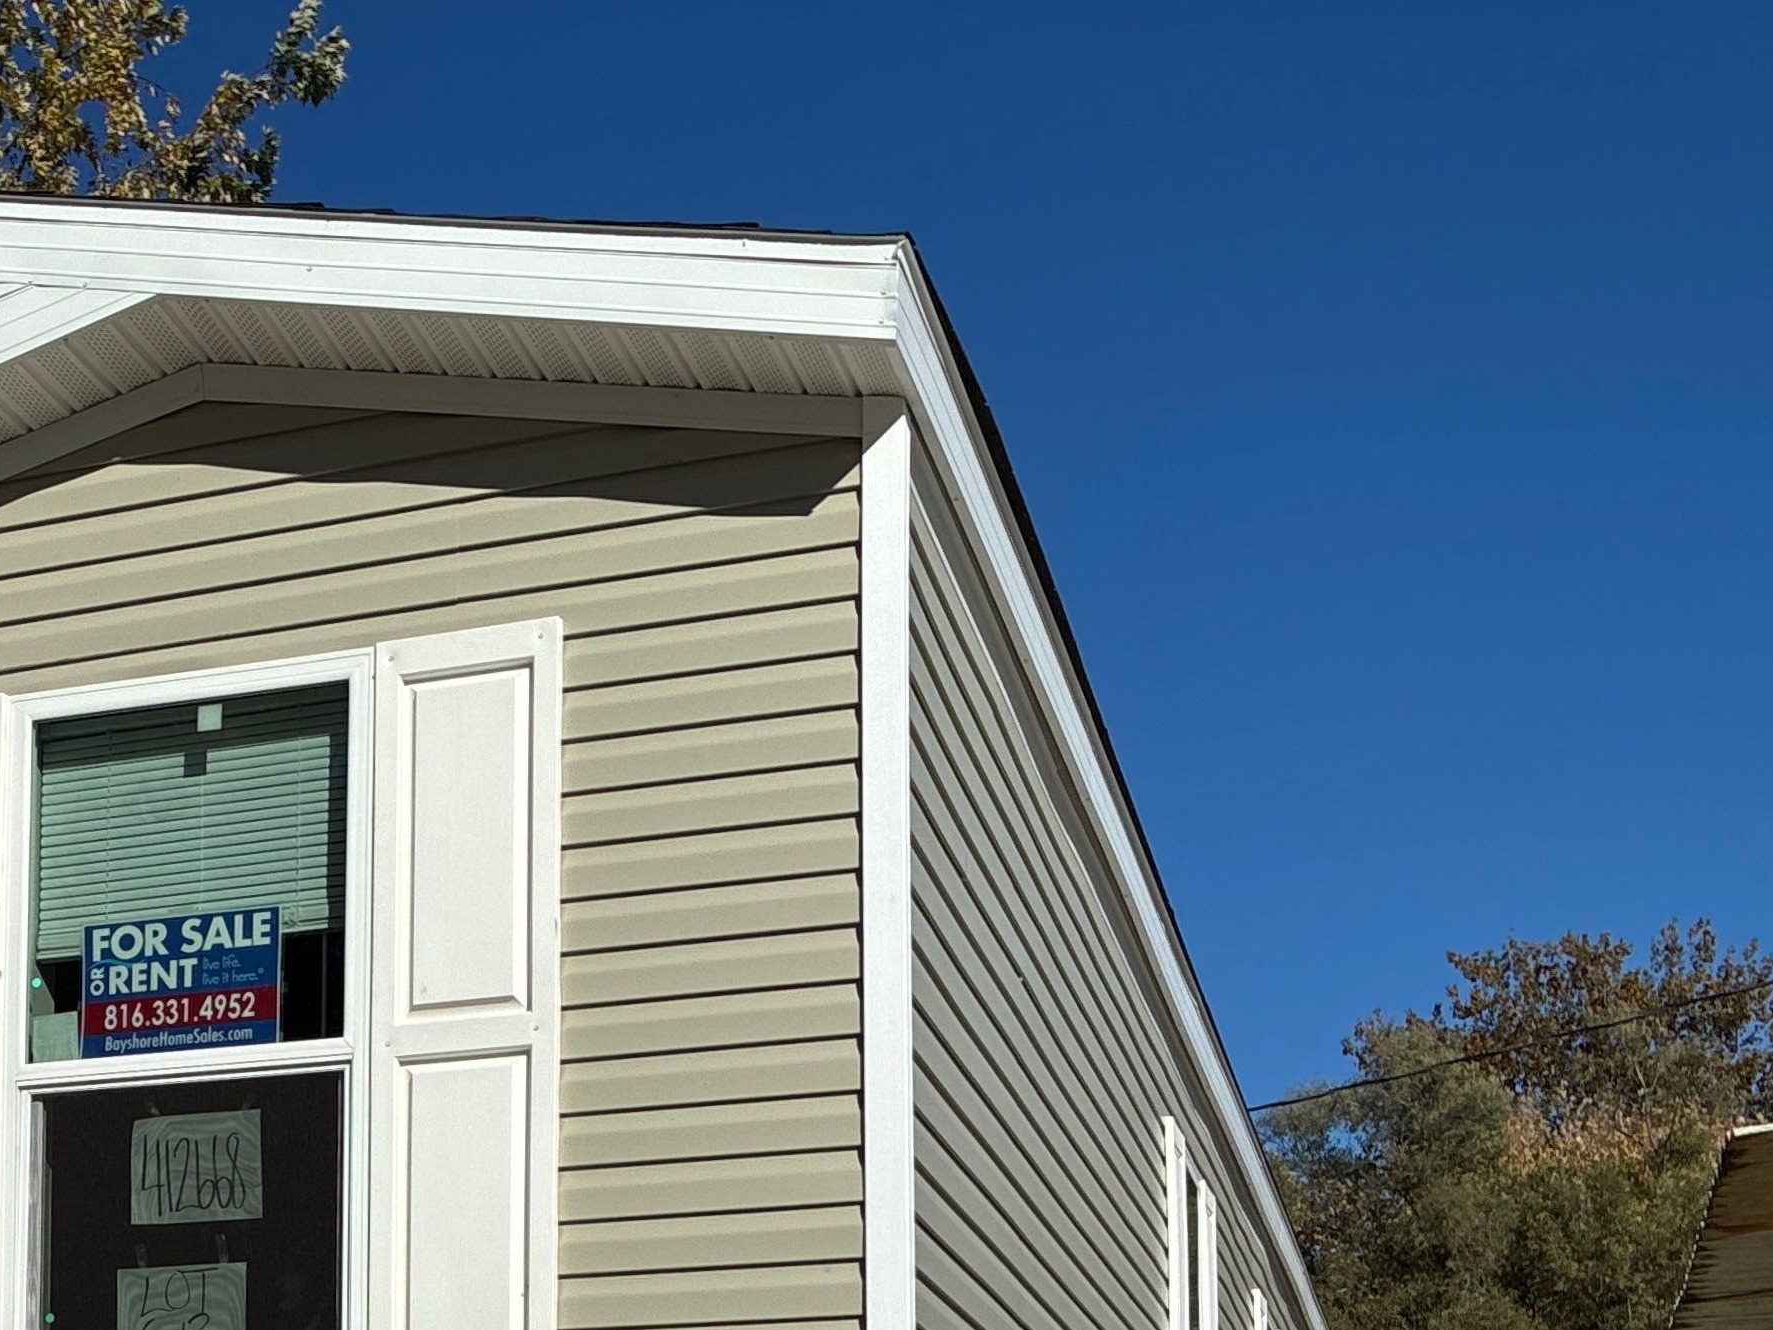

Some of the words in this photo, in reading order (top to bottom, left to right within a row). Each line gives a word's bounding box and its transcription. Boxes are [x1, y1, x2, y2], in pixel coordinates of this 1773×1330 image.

[92, 922, 169, 962] FOR
[181, 911, 271, 953] SALE
[109, 958, 198, 995] RENT
[202, 956, 220, 970] live
[202, 971, 220, 985] live
[222, 971, 229, 984] it
[90, 967, 105, 996] OR
[104, 991, 255, 1030] 816.331.4952
[105, 1026, 253, 1053] BayshoreHomeSales.com
[141, 1267, 219, 1317] LOT
